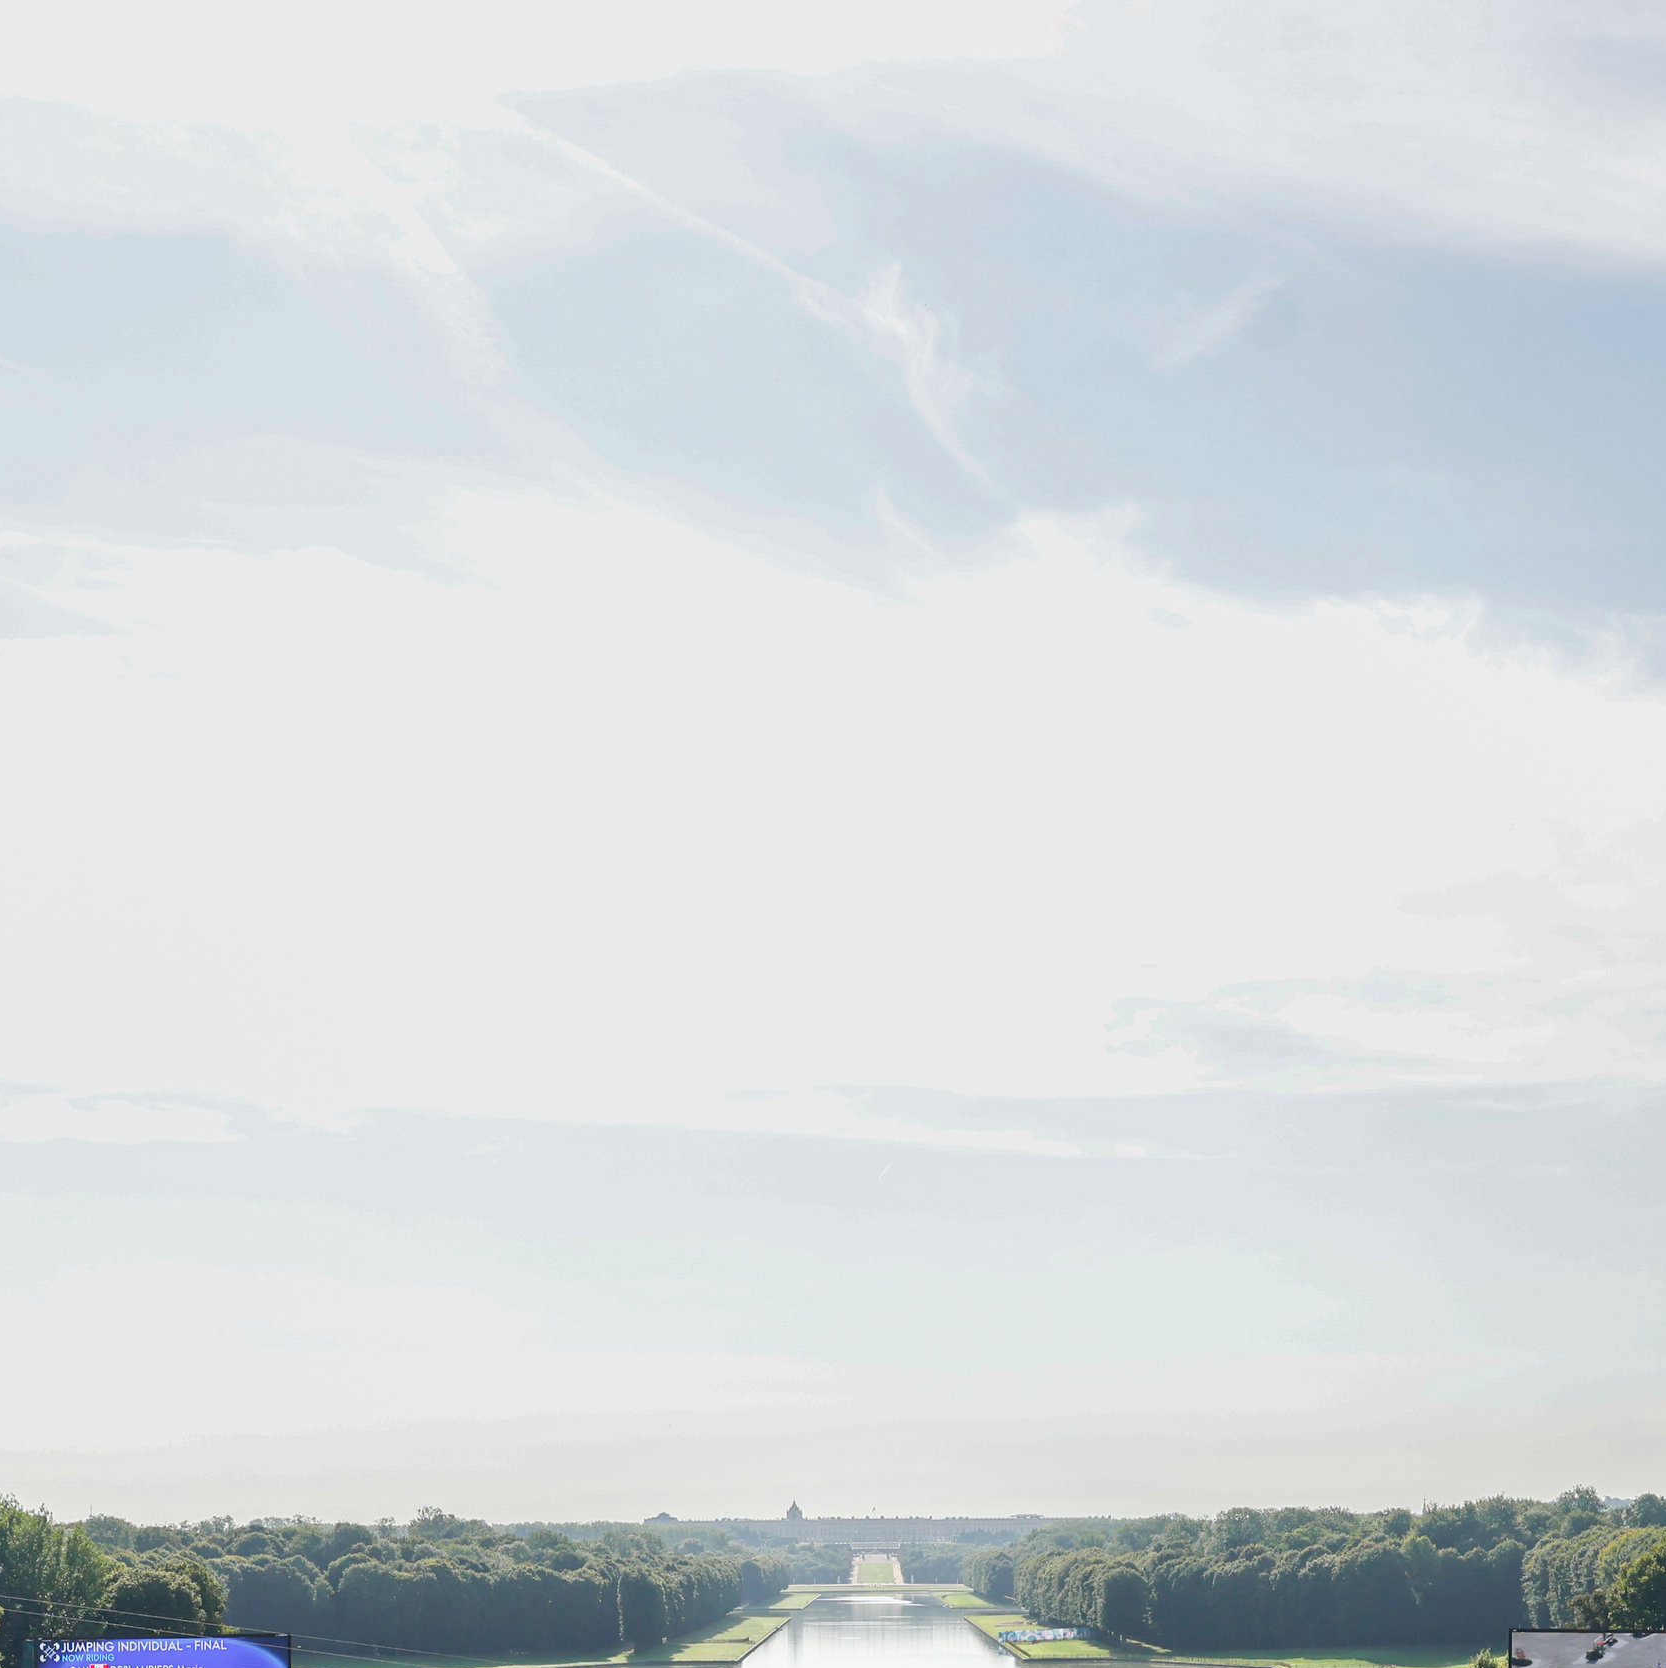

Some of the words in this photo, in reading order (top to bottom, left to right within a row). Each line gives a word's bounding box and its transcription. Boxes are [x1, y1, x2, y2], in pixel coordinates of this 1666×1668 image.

[61, 1641, 115, 1653] JUMPING
[117, 1641, 183, 1652] INDIVIDUAL
[195, 1640, 227, 1650] FINAL
[62, 1654, 84, 1662] NOW
[86, 1653, 115, 1662] RIDING
